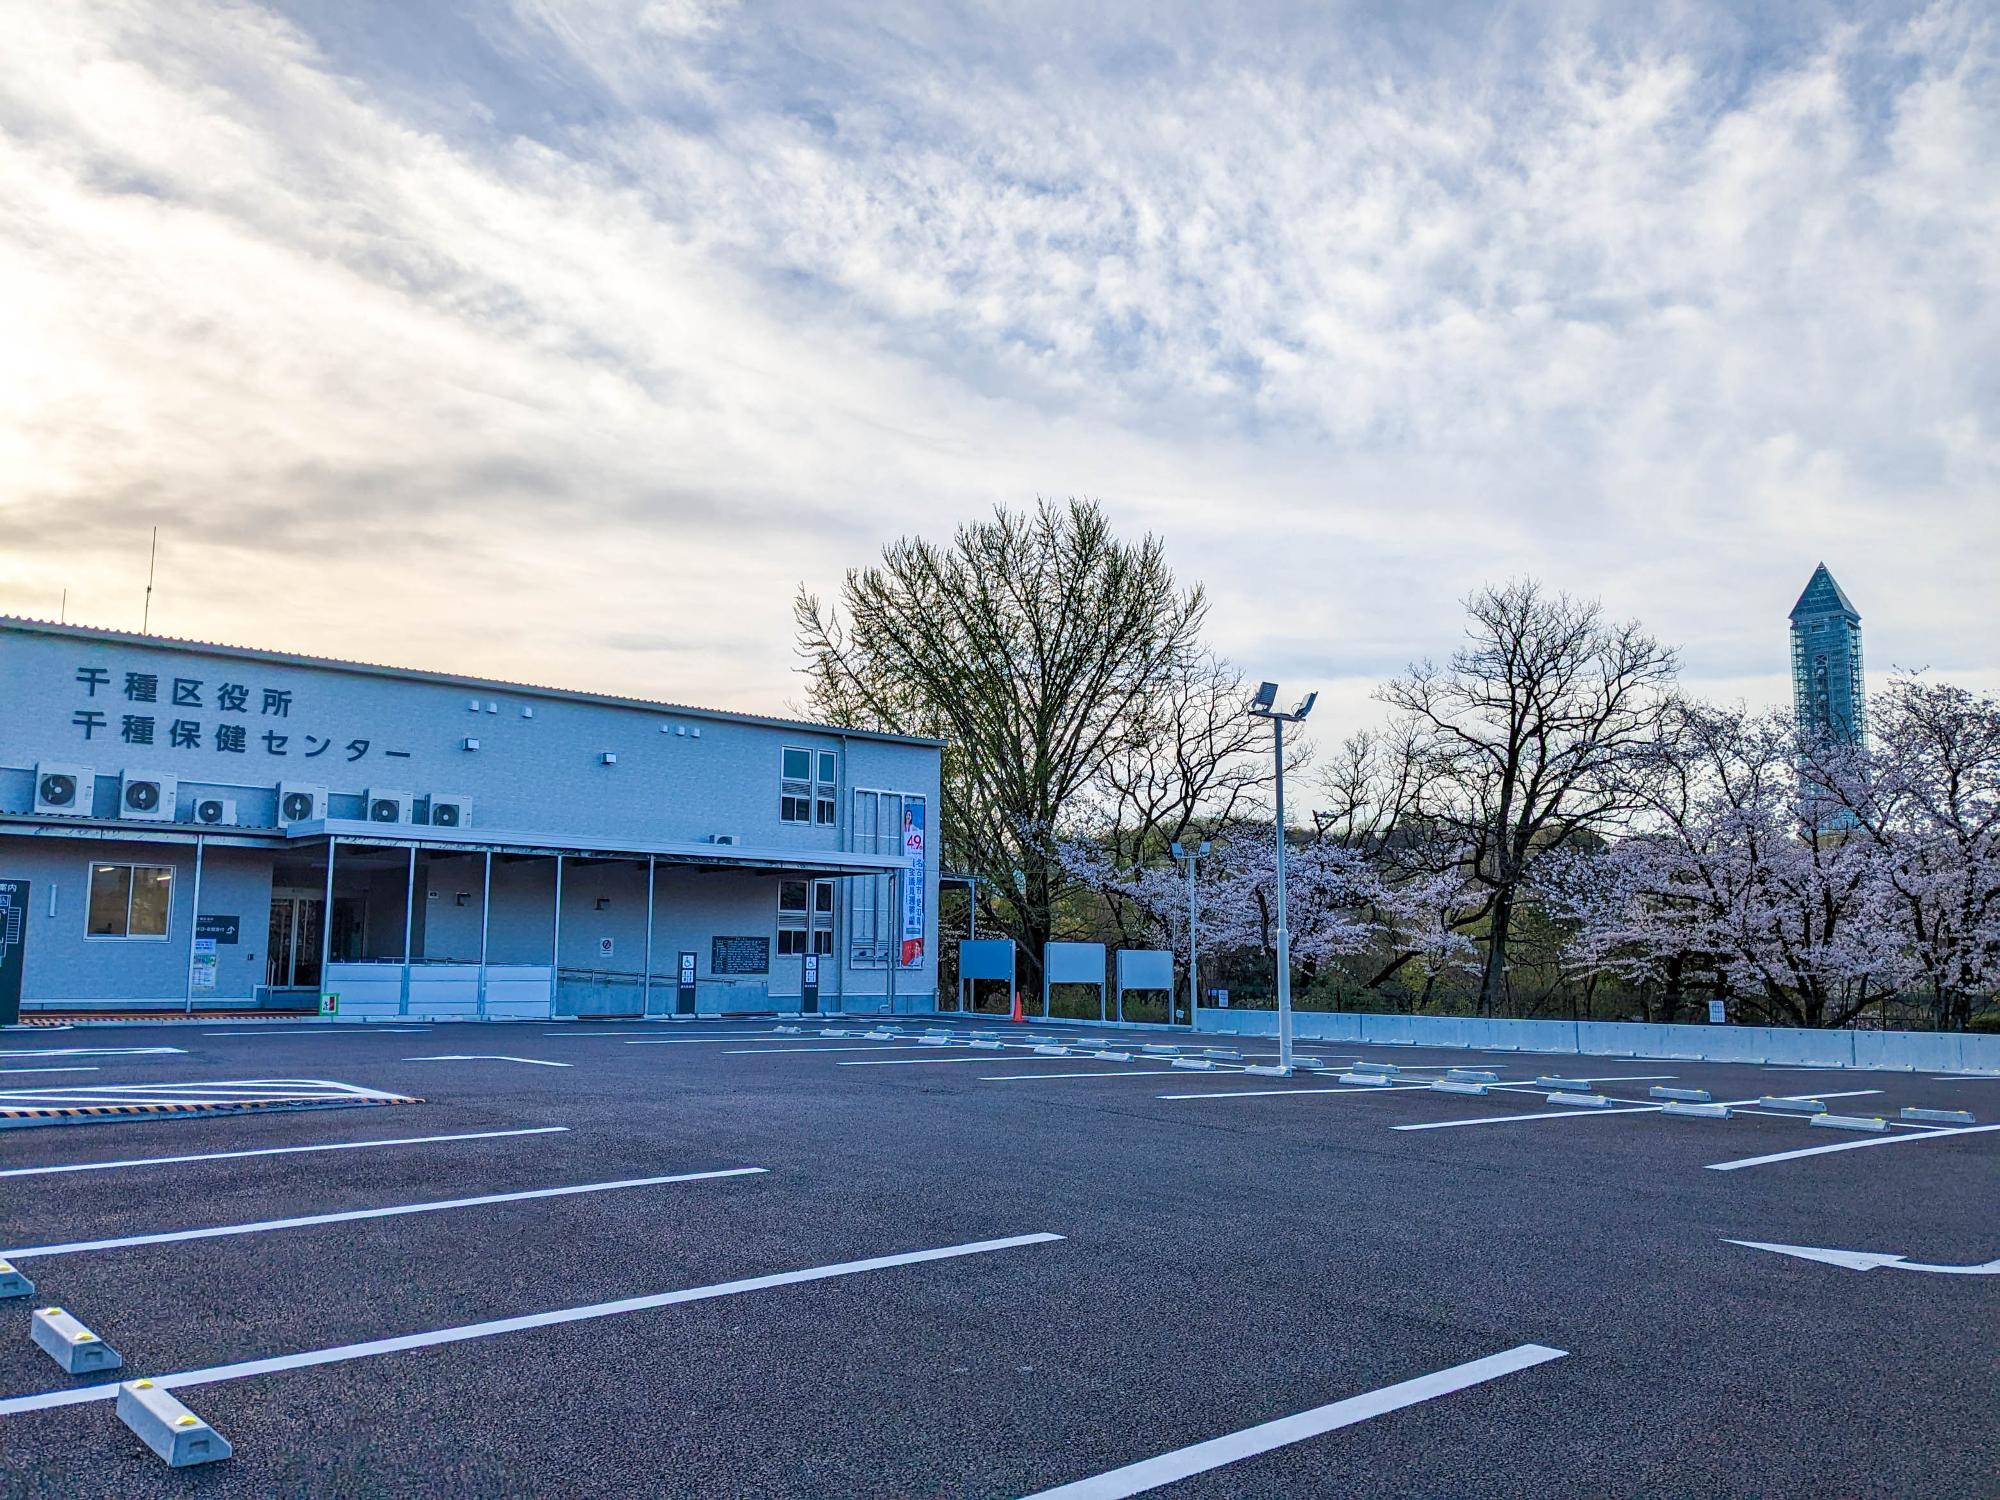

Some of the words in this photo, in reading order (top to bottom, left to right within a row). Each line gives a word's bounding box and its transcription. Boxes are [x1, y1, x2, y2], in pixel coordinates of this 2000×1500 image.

[76, 667, 292, 718] 千種区役所
[72, 710, 411, 762] 千種保健センター
